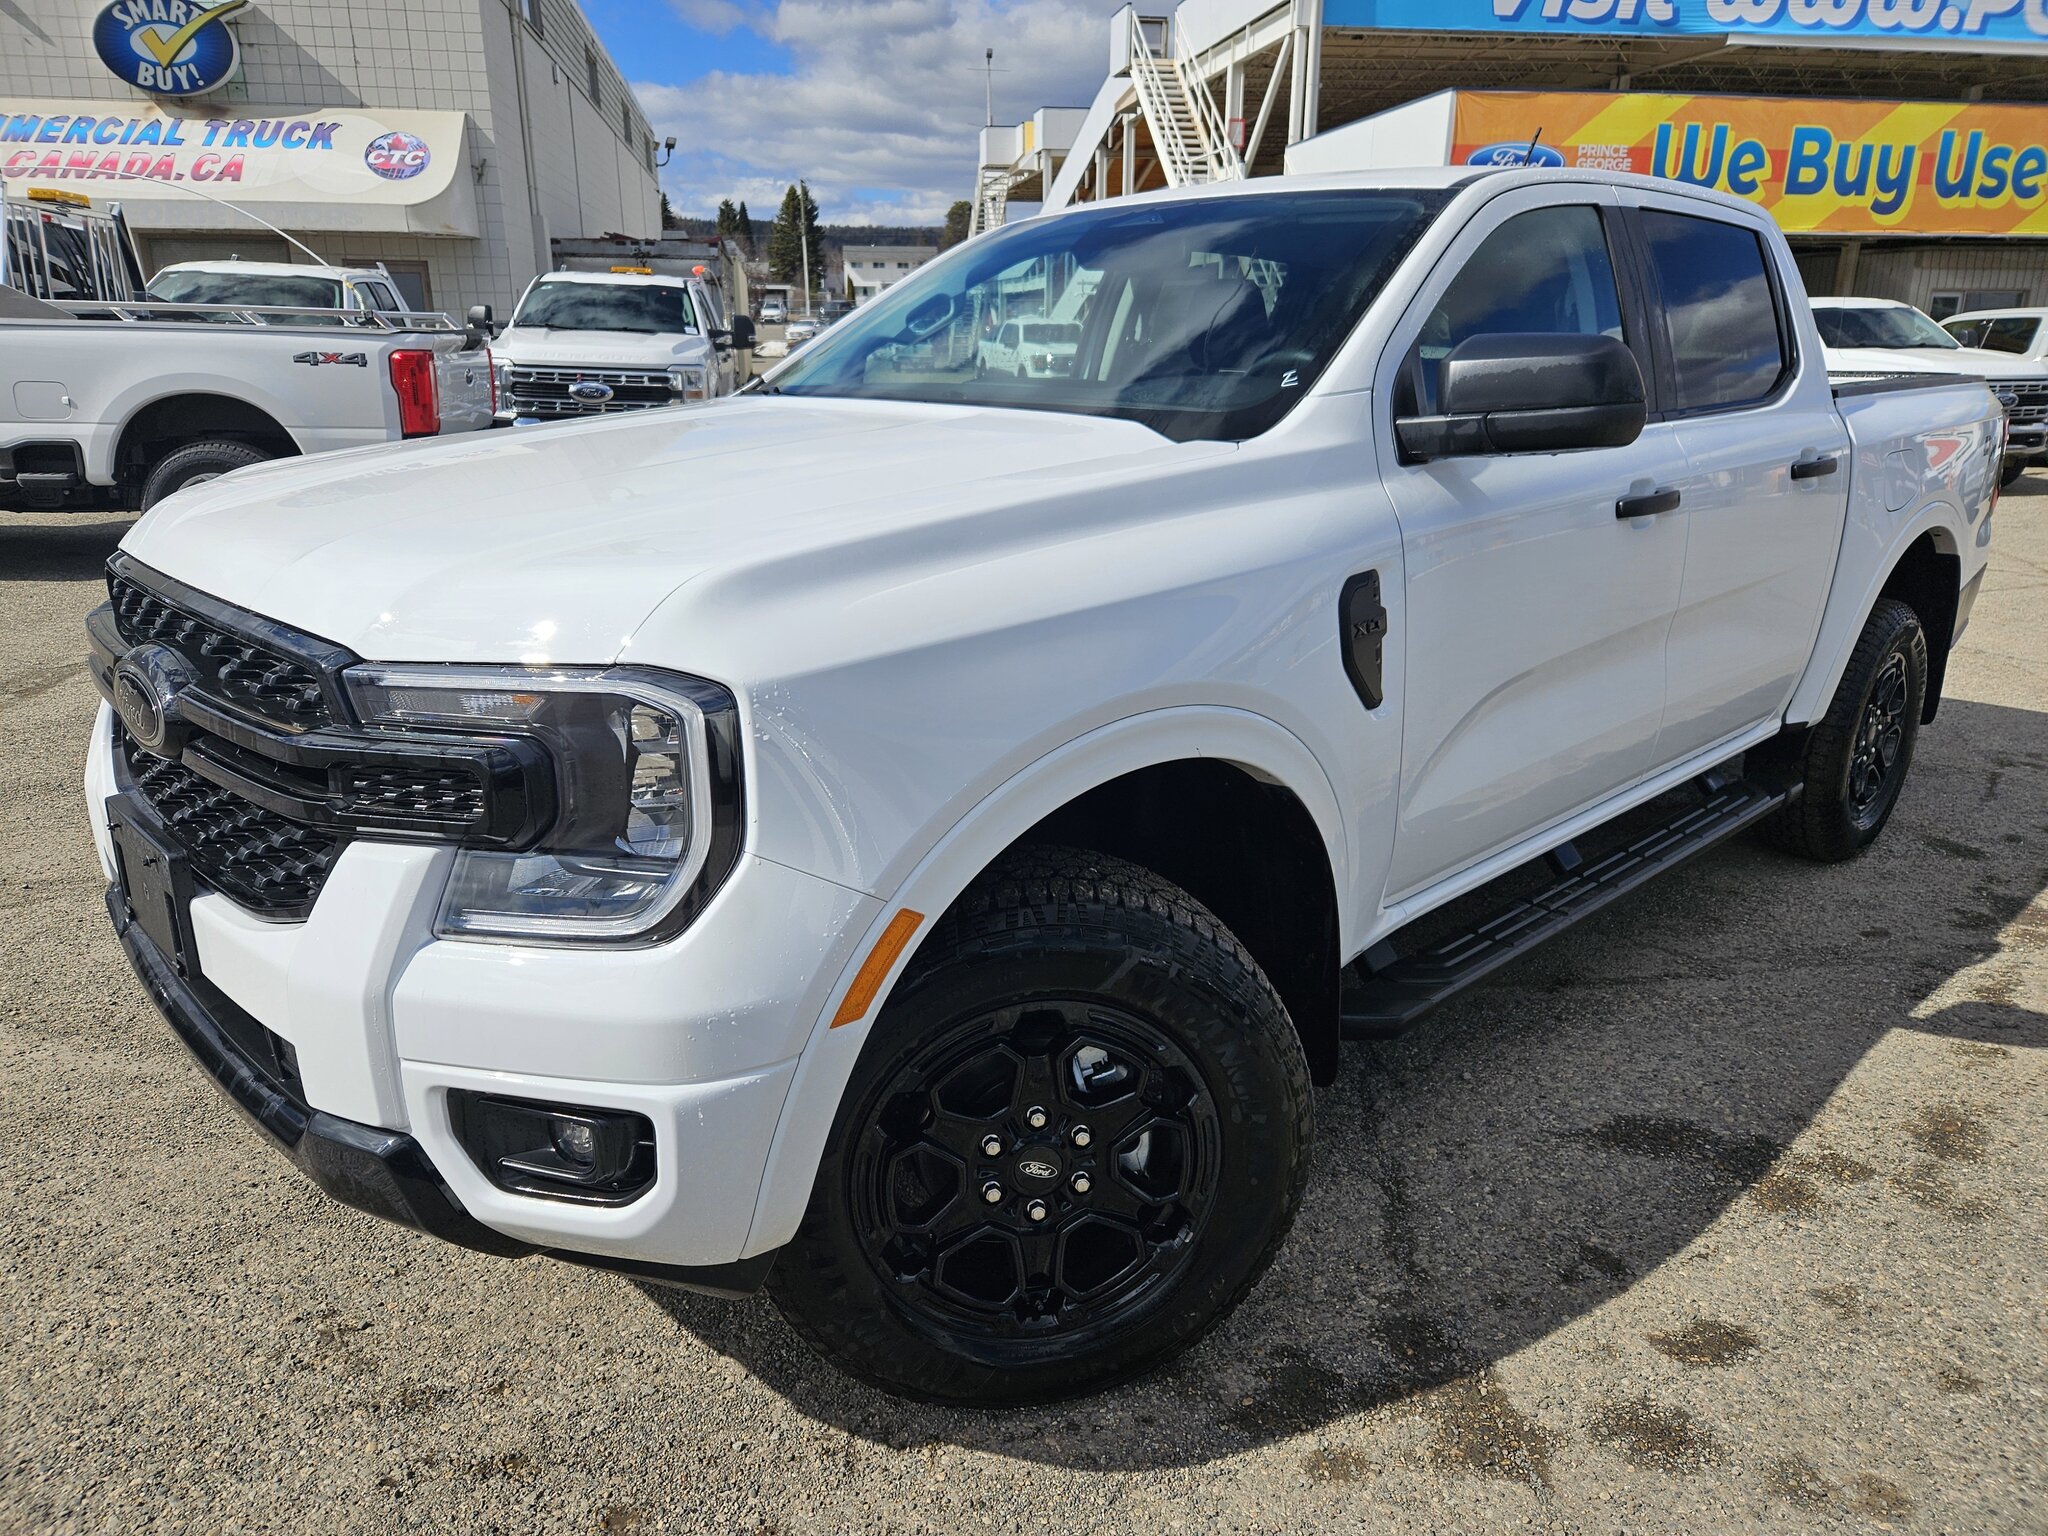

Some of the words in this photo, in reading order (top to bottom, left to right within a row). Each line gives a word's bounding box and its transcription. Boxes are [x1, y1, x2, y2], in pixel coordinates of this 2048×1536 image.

[112, 0, 203, 30] SMART
[137, 61, 205, 91] BUY!
[0, 113, 185, 146] MERCIAL
[202, 119, 343, 150] TRUCK
[367, 150, 426, 166] CTC
[1576, 157, 1632, 171] GEORGE
[1577, 144, 1629, 157] PRINCE
[3, 150, 245, 182] CANADA.CA
[1652, 122, 1766, 195] We
[1784, 126, 1916, 216] Buy
[118, 680, 145, 730] Ford
[1025, 1163, 1052, 1176] Ford
